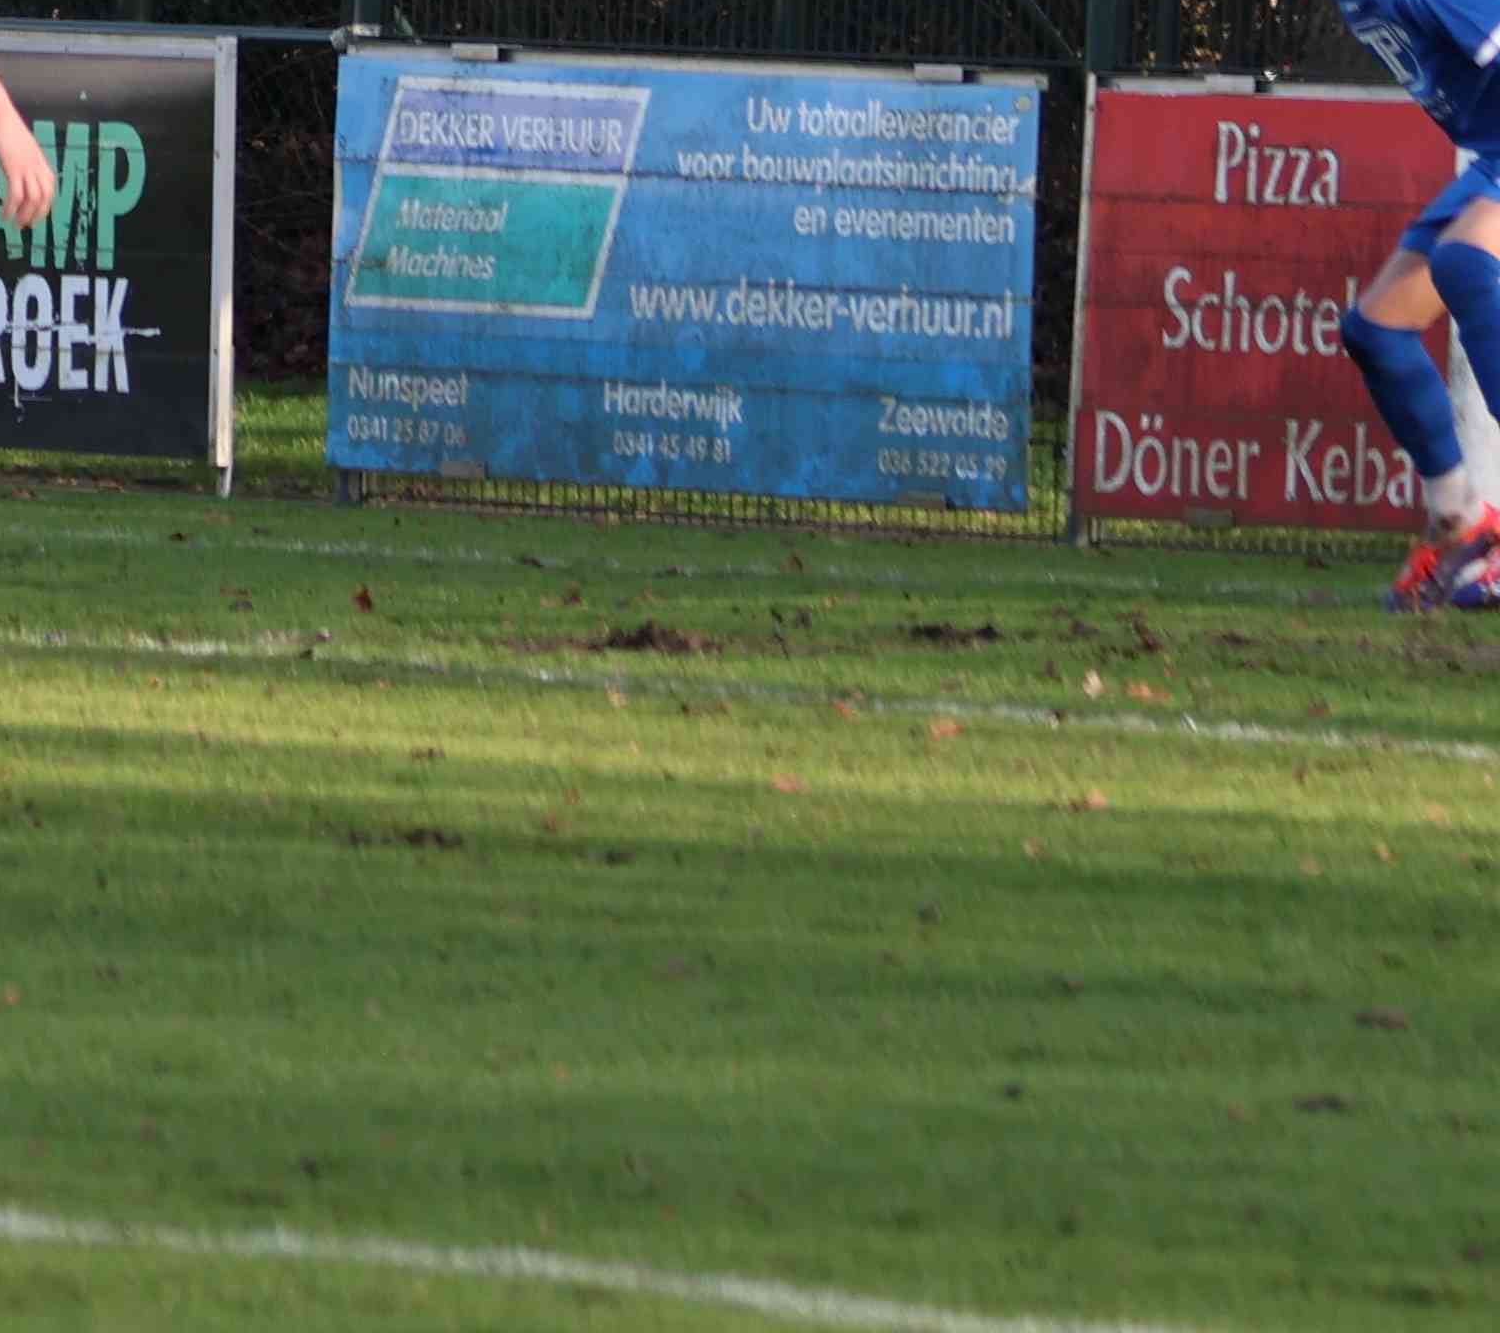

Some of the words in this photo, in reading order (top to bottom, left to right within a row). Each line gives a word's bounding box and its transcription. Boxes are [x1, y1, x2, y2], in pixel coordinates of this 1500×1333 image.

[400, 110, 495, 150] DEKKER
[501, 114, 624, 155] VERHUUR
[746, 96, 792, 134] Uw
[798, 100, 1020, 146] totaalleverancier
[677, 149, 734, 180] voor
[742, 143, 1015, 205] bouwplaatsinrichting
[1214, 120, 1339, 207] Pizza
[396, 196, 509, 233] Materiaal
[794, 204, 827, 236] en
[834, 205, 1015, 246] evenementen
[387, 244, 496, 279] Machines
[629, 275, 1013, 340] www.dekker-verhuur.nl
[349, 366, 469, 412] Nunspeet
[603, 379, 743, 432] Harderwijk
[877, 394, 1009, 442] Zeewolde
[1093, 409, 1261, 502] Döner
[1284, 418, 1416, 509] Keba
